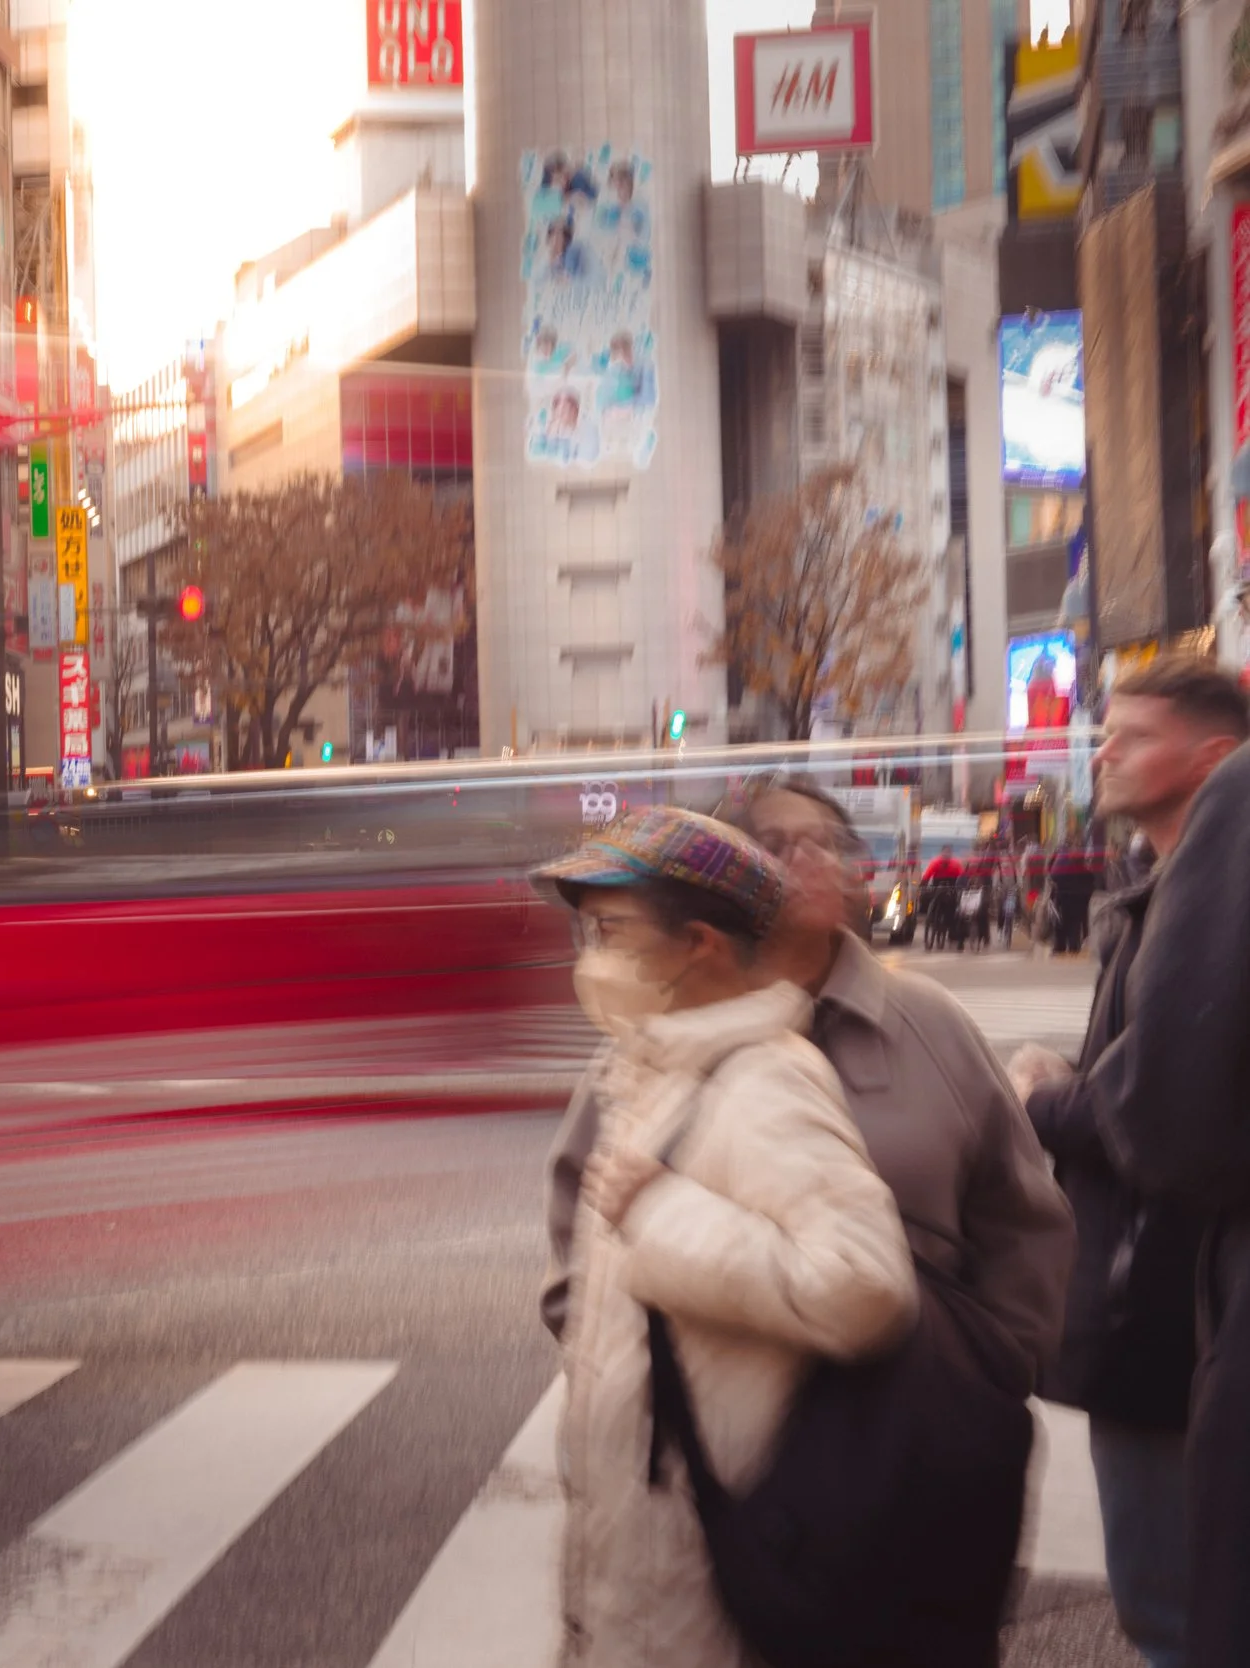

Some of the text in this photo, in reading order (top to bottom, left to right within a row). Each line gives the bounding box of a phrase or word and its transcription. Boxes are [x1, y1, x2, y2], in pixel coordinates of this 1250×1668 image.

[378, 0, 445, 41] UNI
[379, 40, 453, 87] QLO
[769, 57, 840, 117] H&M
